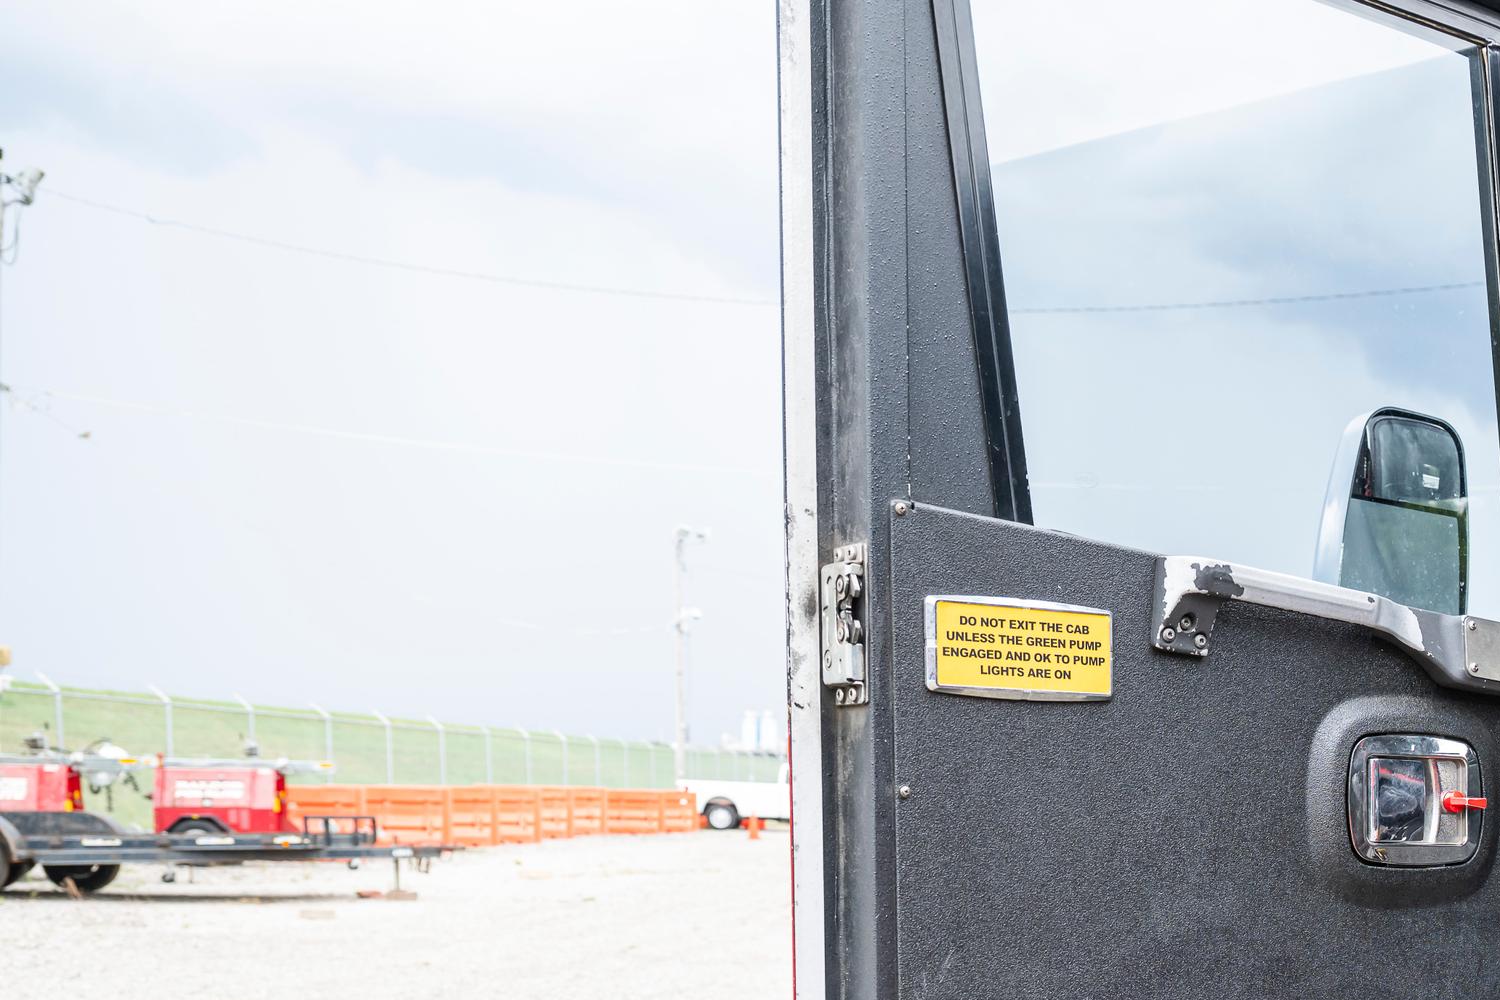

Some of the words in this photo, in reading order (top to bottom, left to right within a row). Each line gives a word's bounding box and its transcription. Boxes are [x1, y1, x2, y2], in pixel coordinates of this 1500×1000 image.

[960, 616, 976, 626] DO
[981, 617, 1005, 628] NOT
[1010, 620, 1036, 630] EXIT
[1040, 622, 1062, 632] THE
[1066, 624, 1089, 634] CAB
[946, 631, 995, 643] UNLESS
[999, 635, 1023, 645] THE
[1026, 637, 1066, 648] GREEN
[1070, 640, 1102, 651] PUMP
[943, 647, 1002, 659] ENGAGED
[1006, 651, 1030, 661] AND
[1034, 653, 1051, 663] OK
[1054, 654, 1070, 664] TO
[1074, 656, 1105, 666] PUMP
[981, 665, 1024, 677] LIGHTS
[1028, 668, 1051, 678] ARE
[1054, 670, 1071, 680] ON
